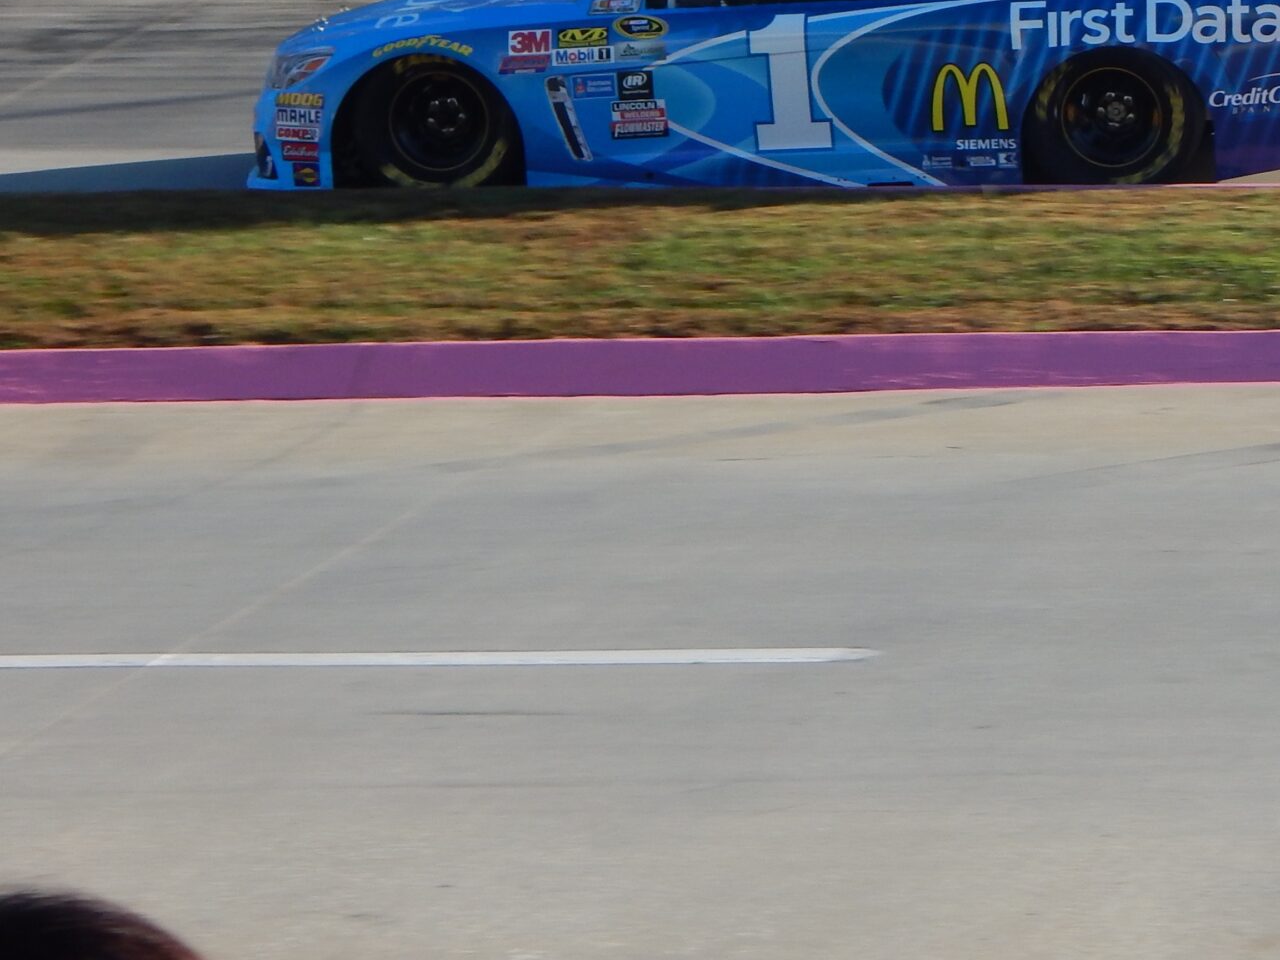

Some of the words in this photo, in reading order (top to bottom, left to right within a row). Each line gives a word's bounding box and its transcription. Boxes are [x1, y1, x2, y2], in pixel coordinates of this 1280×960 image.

[1010, 0, 1134, 51] First
[372, 34, 474, 57] GOODYEAR
[510, 31, 550, 54] 3M
[555, 48, 594, 63] Mobil
[749, 13, 834, 152] 1
[276, 92, 323, 107] MOOG
[613, 102, 655, 112] LINCOLN
[276, 109, 321, 124] MAHLE
[956, 138, 1017, 151] SIEMENS
